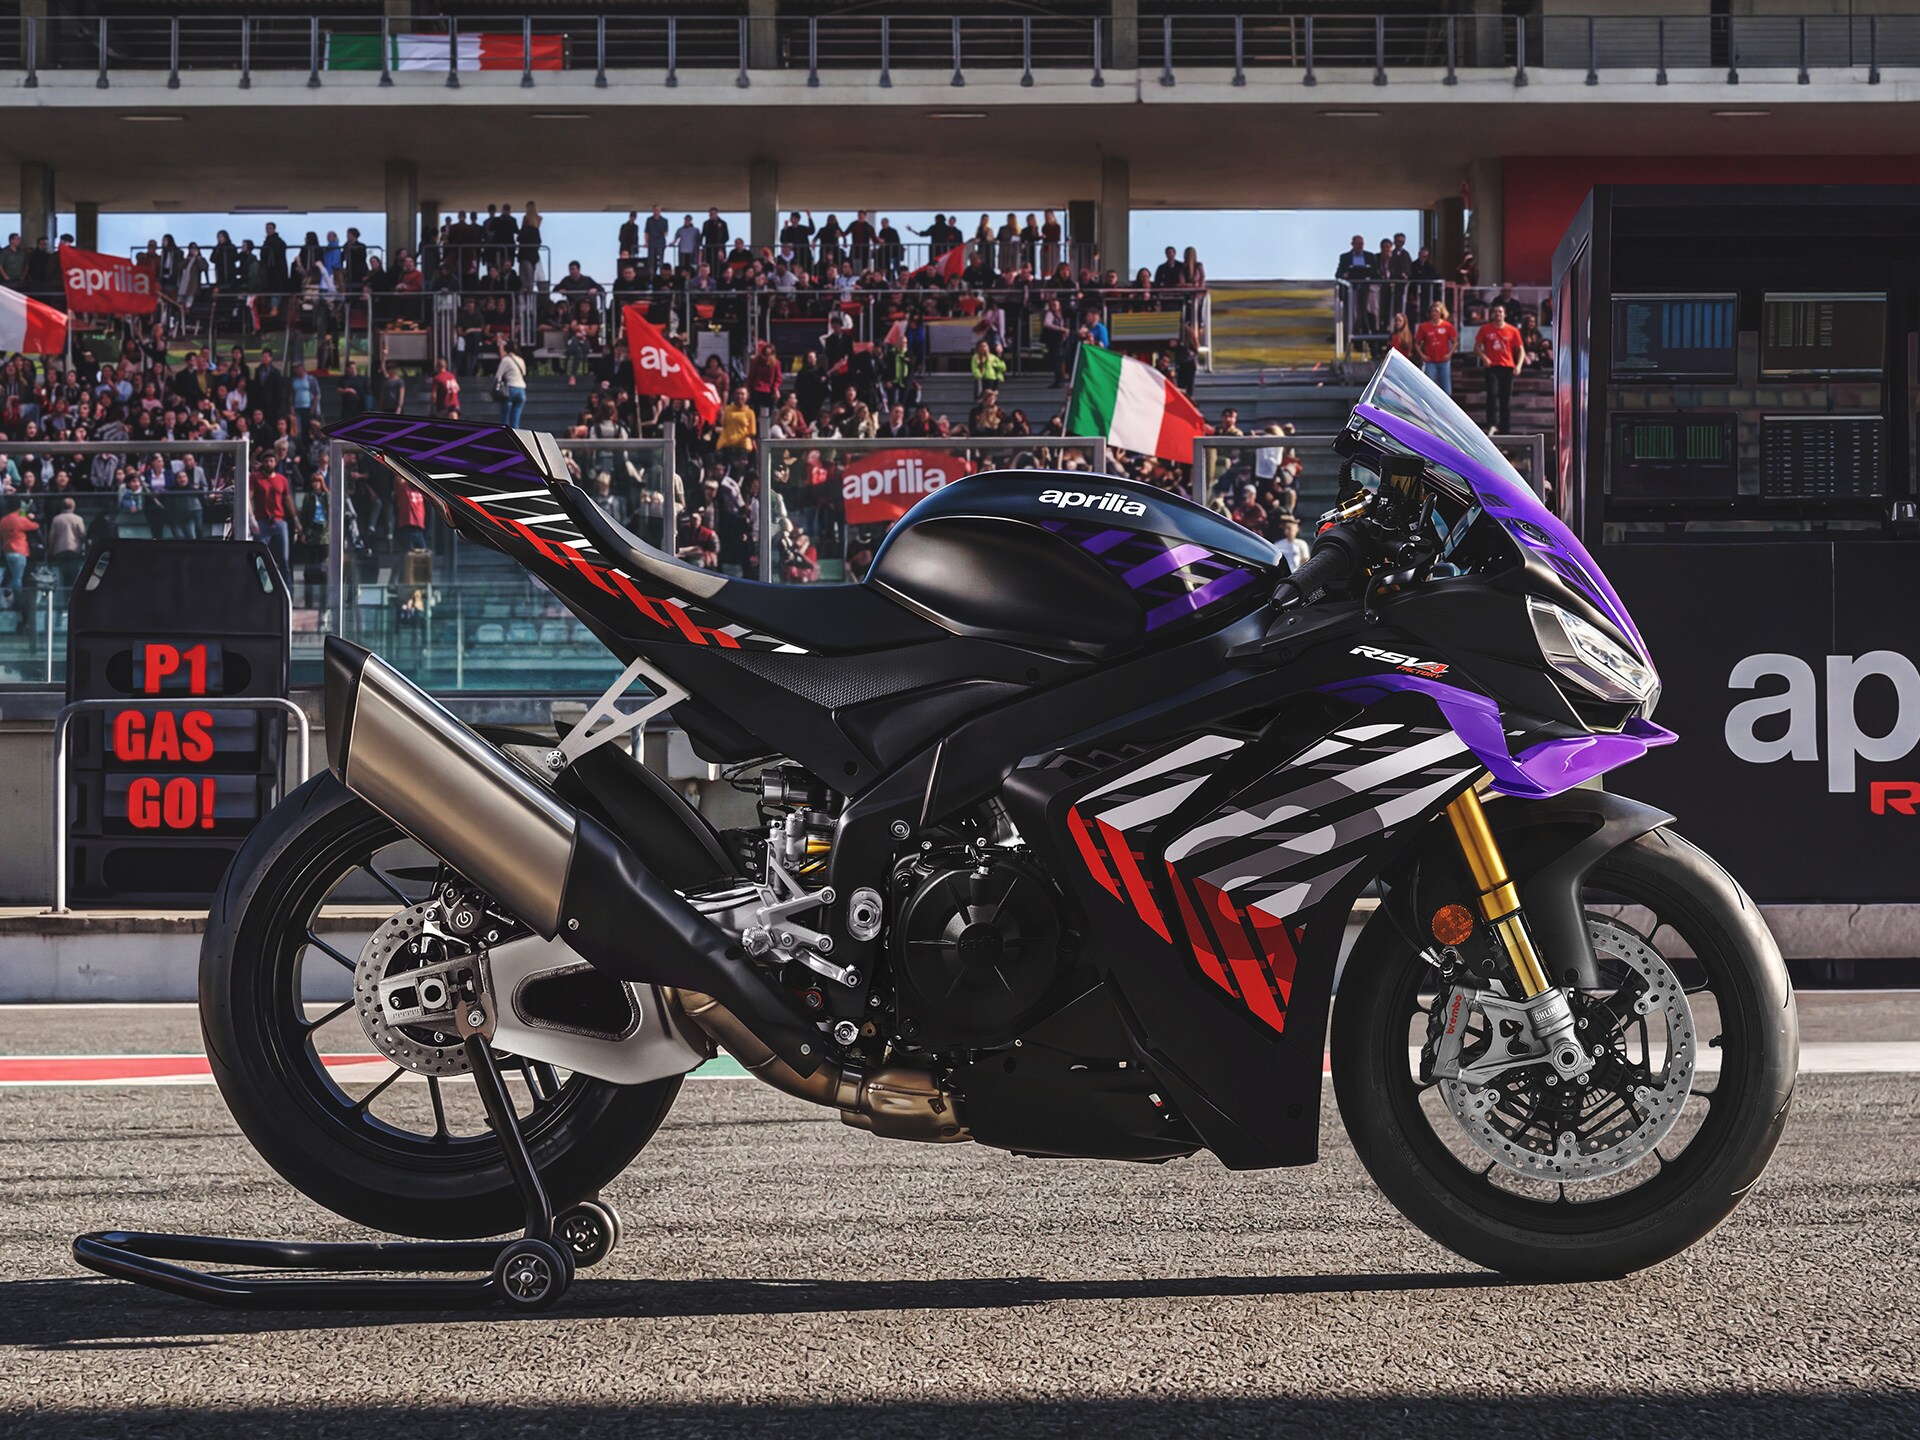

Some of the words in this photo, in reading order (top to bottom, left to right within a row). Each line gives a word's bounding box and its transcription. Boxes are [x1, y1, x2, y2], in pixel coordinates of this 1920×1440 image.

[67, 264, 150, 295] aprilia
[842, 459, 947, 504] aprilia
[1038, 489, 1147, 517] aprilia
[144, 643, 207, 694] P1
[1349, 645, 1450, 674] RSV4
[1396, 664, 1444, 679] FACTORY
[113, 709, 214, 762] GAS
[1724, 650, 1920, 793] ap
[127, 777, 216, 829] GO!
[1446, 994, 1463, 1035] brembo
